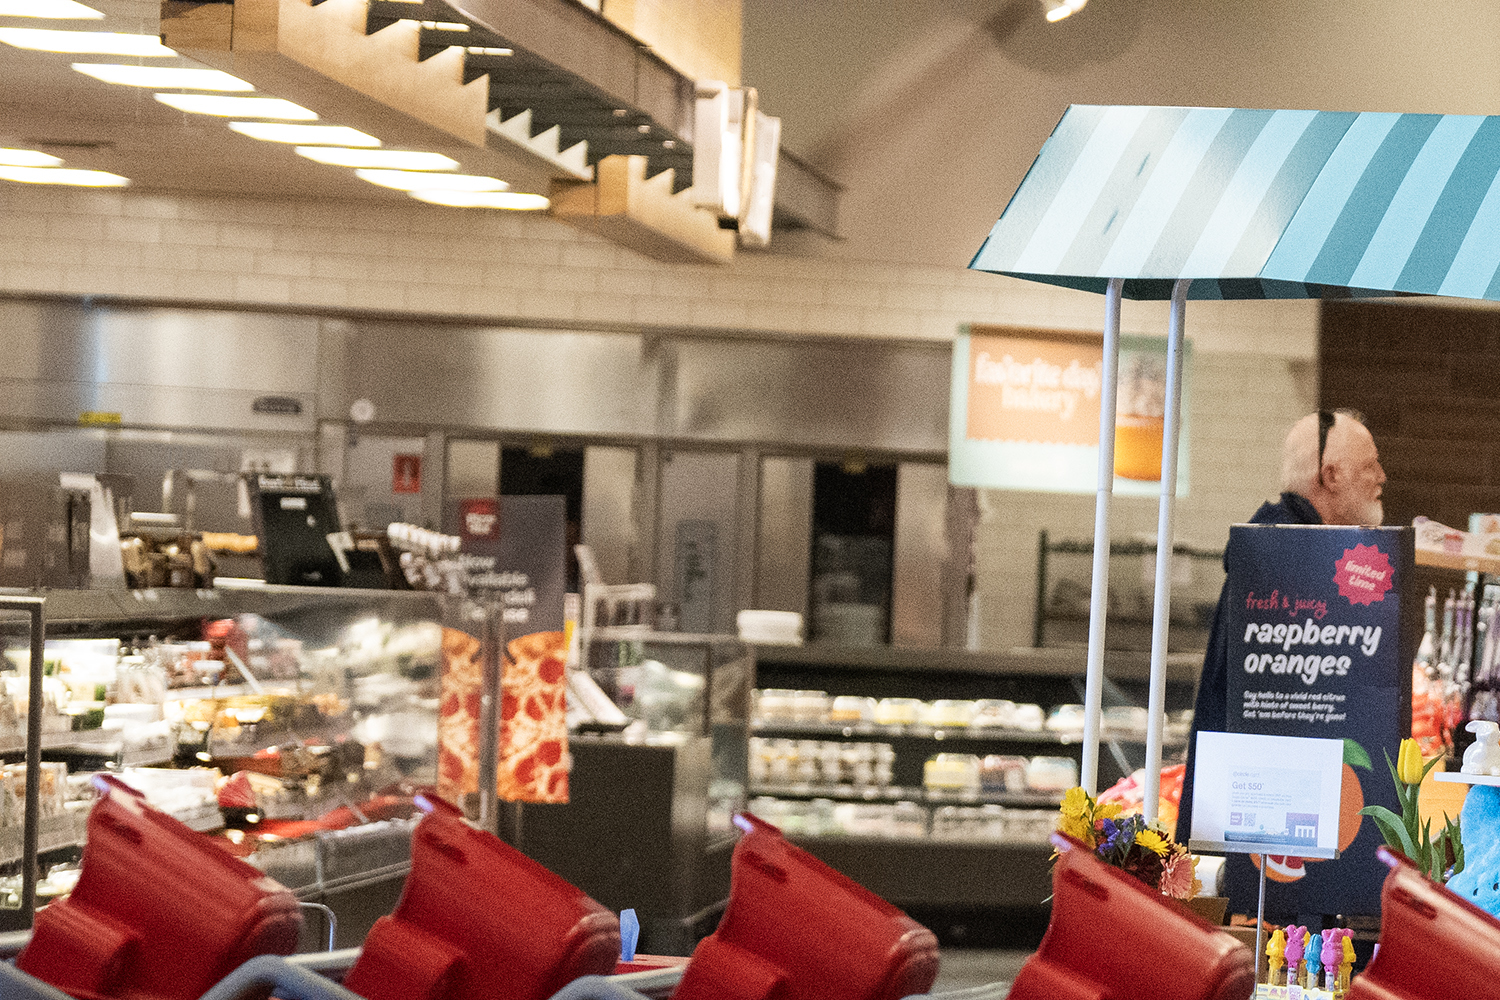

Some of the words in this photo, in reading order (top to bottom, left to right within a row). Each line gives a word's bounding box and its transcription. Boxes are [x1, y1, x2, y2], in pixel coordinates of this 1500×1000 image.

[1344, 560, 1387, 581] limited
[1348, 575, 1376, 591] time
[1246, 589, 1279, 609] fresh
[1288, 594, 1328, 620] juicy
[1243, 617, 1383, 657] raspberry
[1243, 652, 1352, 685] oranges
[1243, 690, 1257, 701] Say
[1258, 691, 1274, 700] hello
[1275, 692, 1284, 700] to
[1290, 692, 1308, 701] vivid
[1308, 692, 1322, 701] red
[1322, 693, 1346, 702] citrus
[1243, 700, 1260, 709] with
[1260, 702, 1280, 710] hints
[1280, 702, 1289, 710] of
[1243, 710, 1256, 719] Get
[1271, 711, 1297, 720] before
[1297, 711, 1325, 723] they're
[1231, 781, 1246, 790] Get
